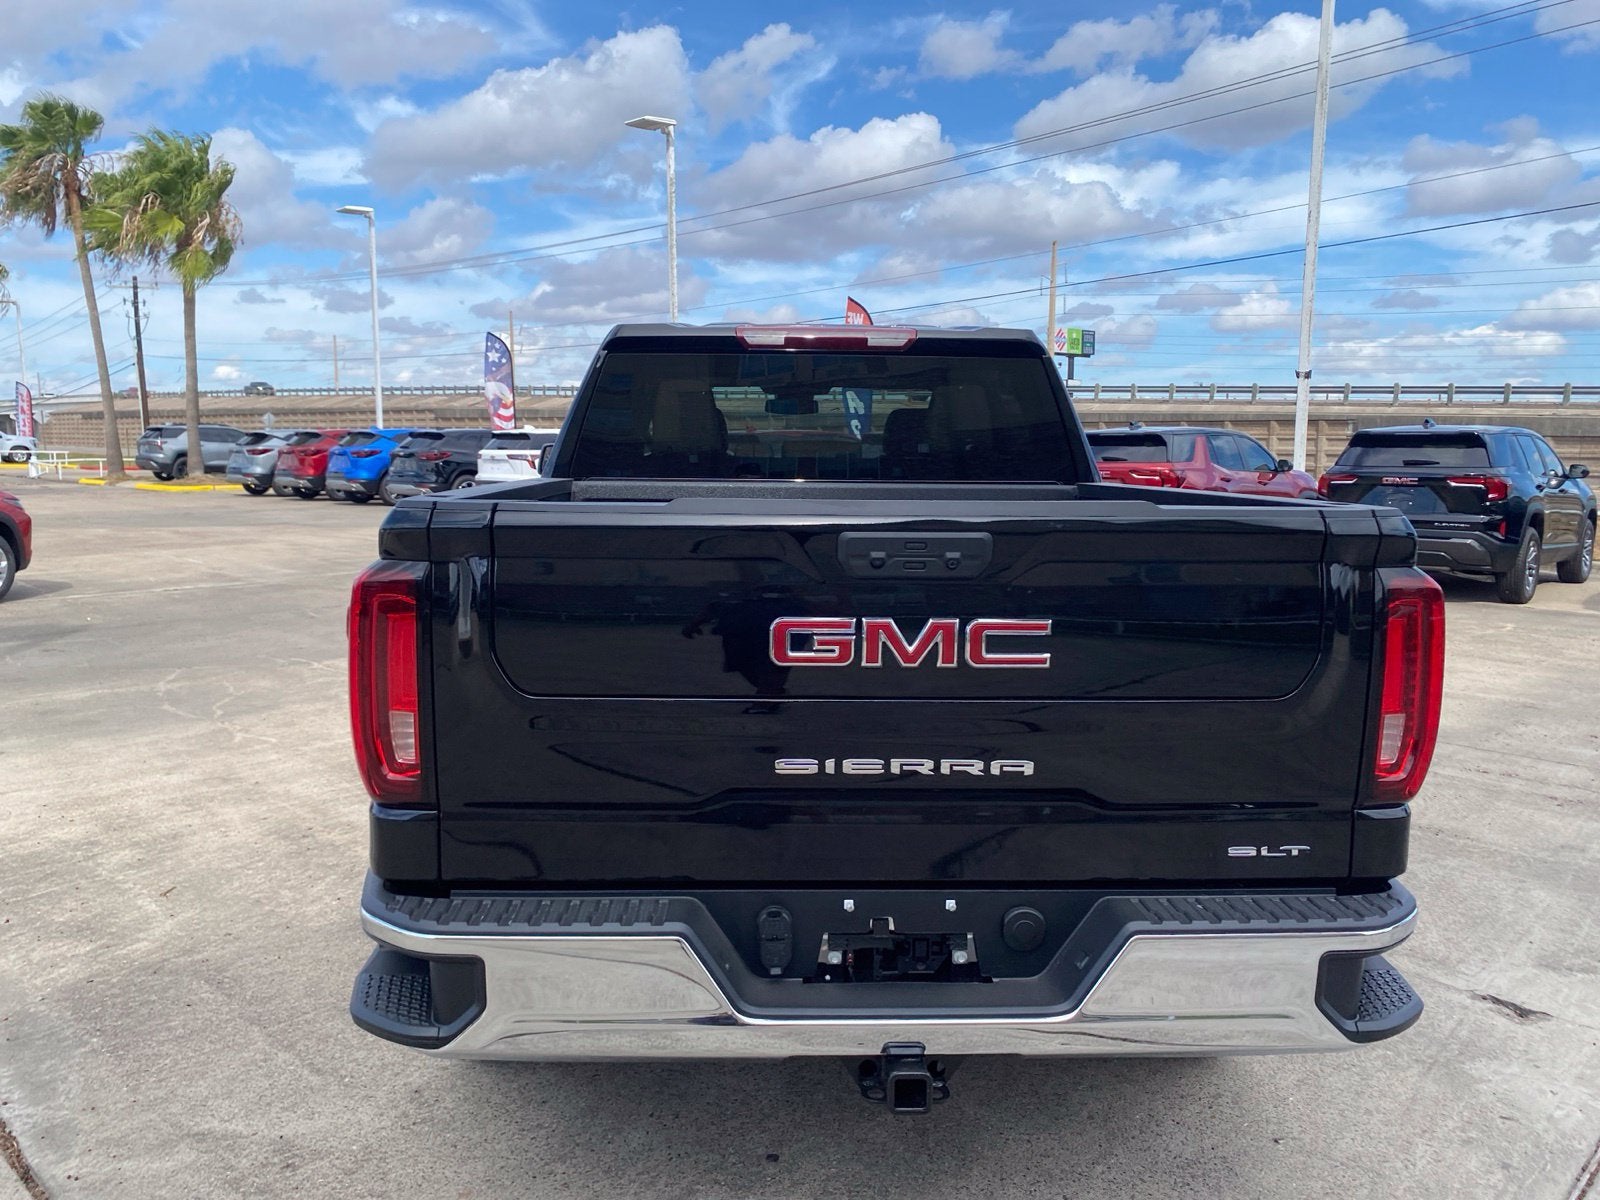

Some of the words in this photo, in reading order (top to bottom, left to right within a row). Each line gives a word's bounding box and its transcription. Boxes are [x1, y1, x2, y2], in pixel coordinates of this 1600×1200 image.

[1381, 477, 1418, 485] GMC
[769, 616, 1052, 668] GMC
[774, 758, 1035, 776] SIERRA
[1227, 845, 1311, 857] SLT
